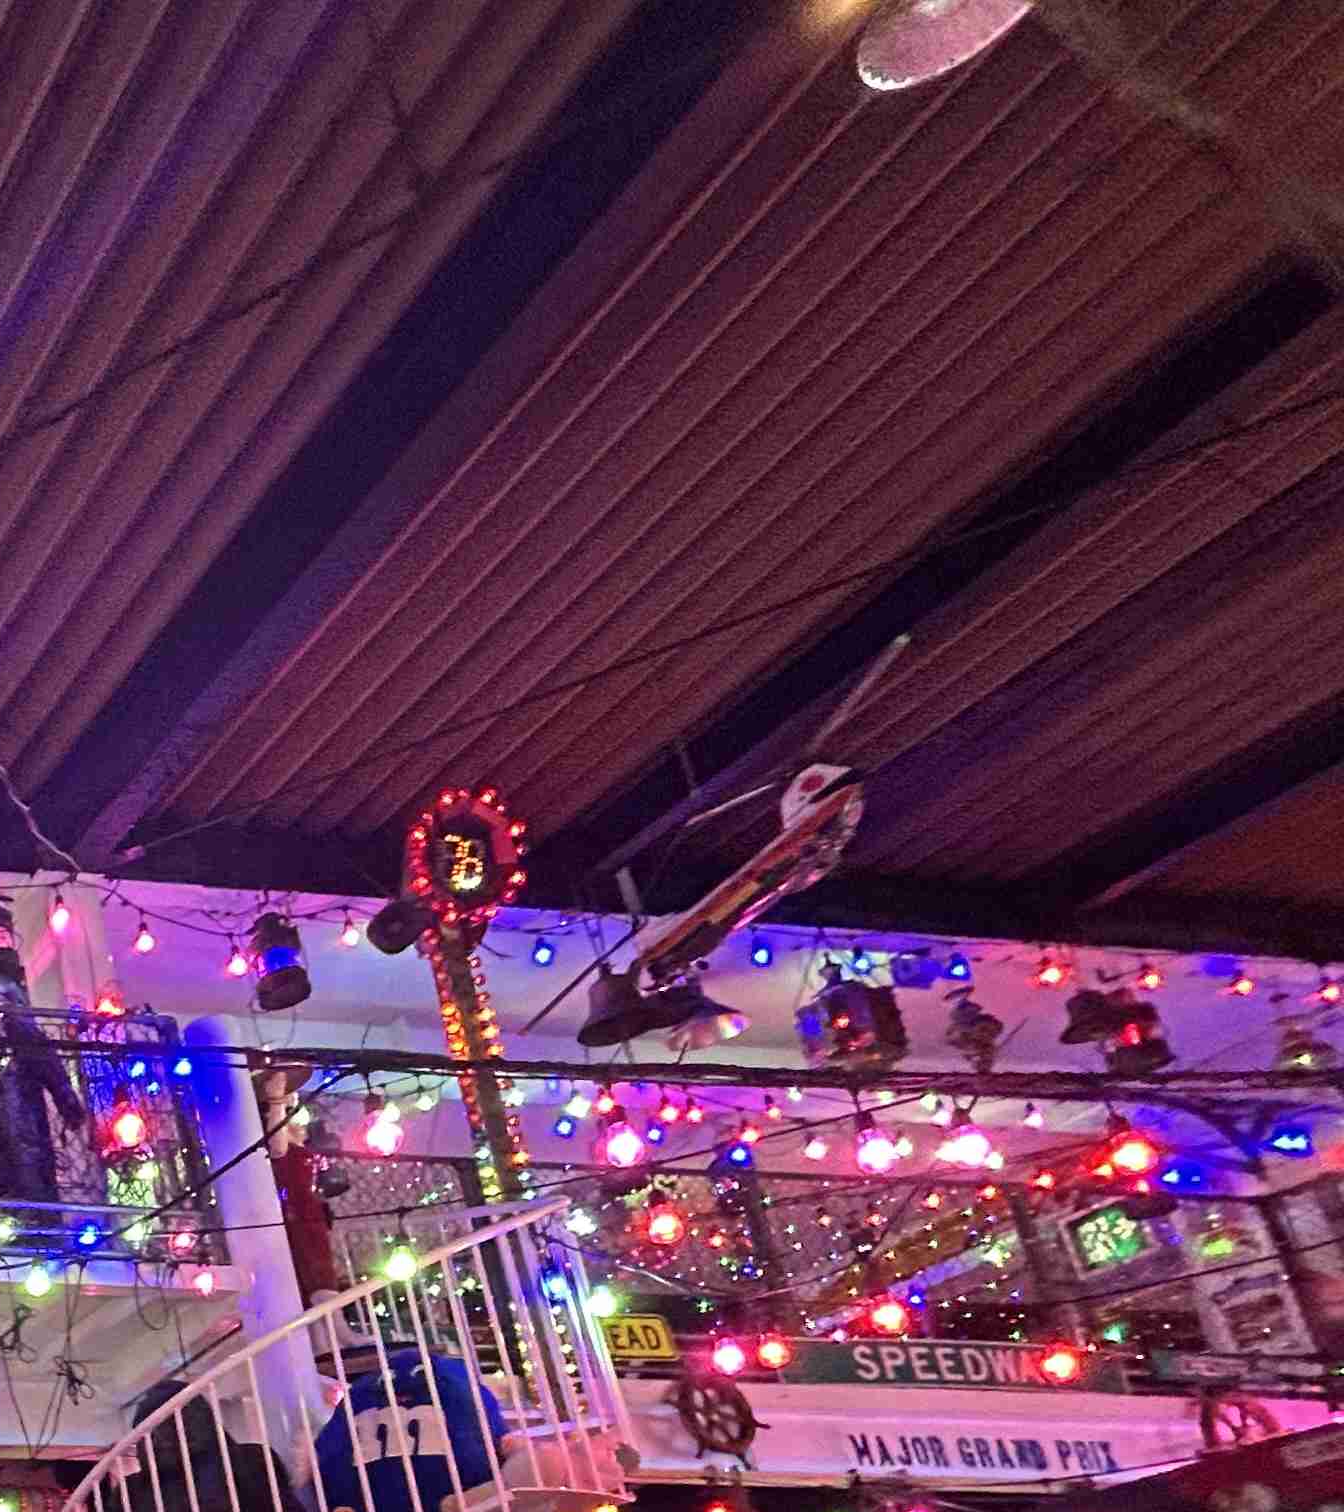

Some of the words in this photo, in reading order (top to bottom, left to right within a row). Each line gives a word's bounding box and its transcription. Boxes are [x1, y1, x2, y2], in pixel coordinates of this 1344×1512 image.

[847, 1434, 946, 1468] MAJOR
[958, 1437, 1048, 1471] GRAND
[1057, 1439, 1120, 1472] PRIX
